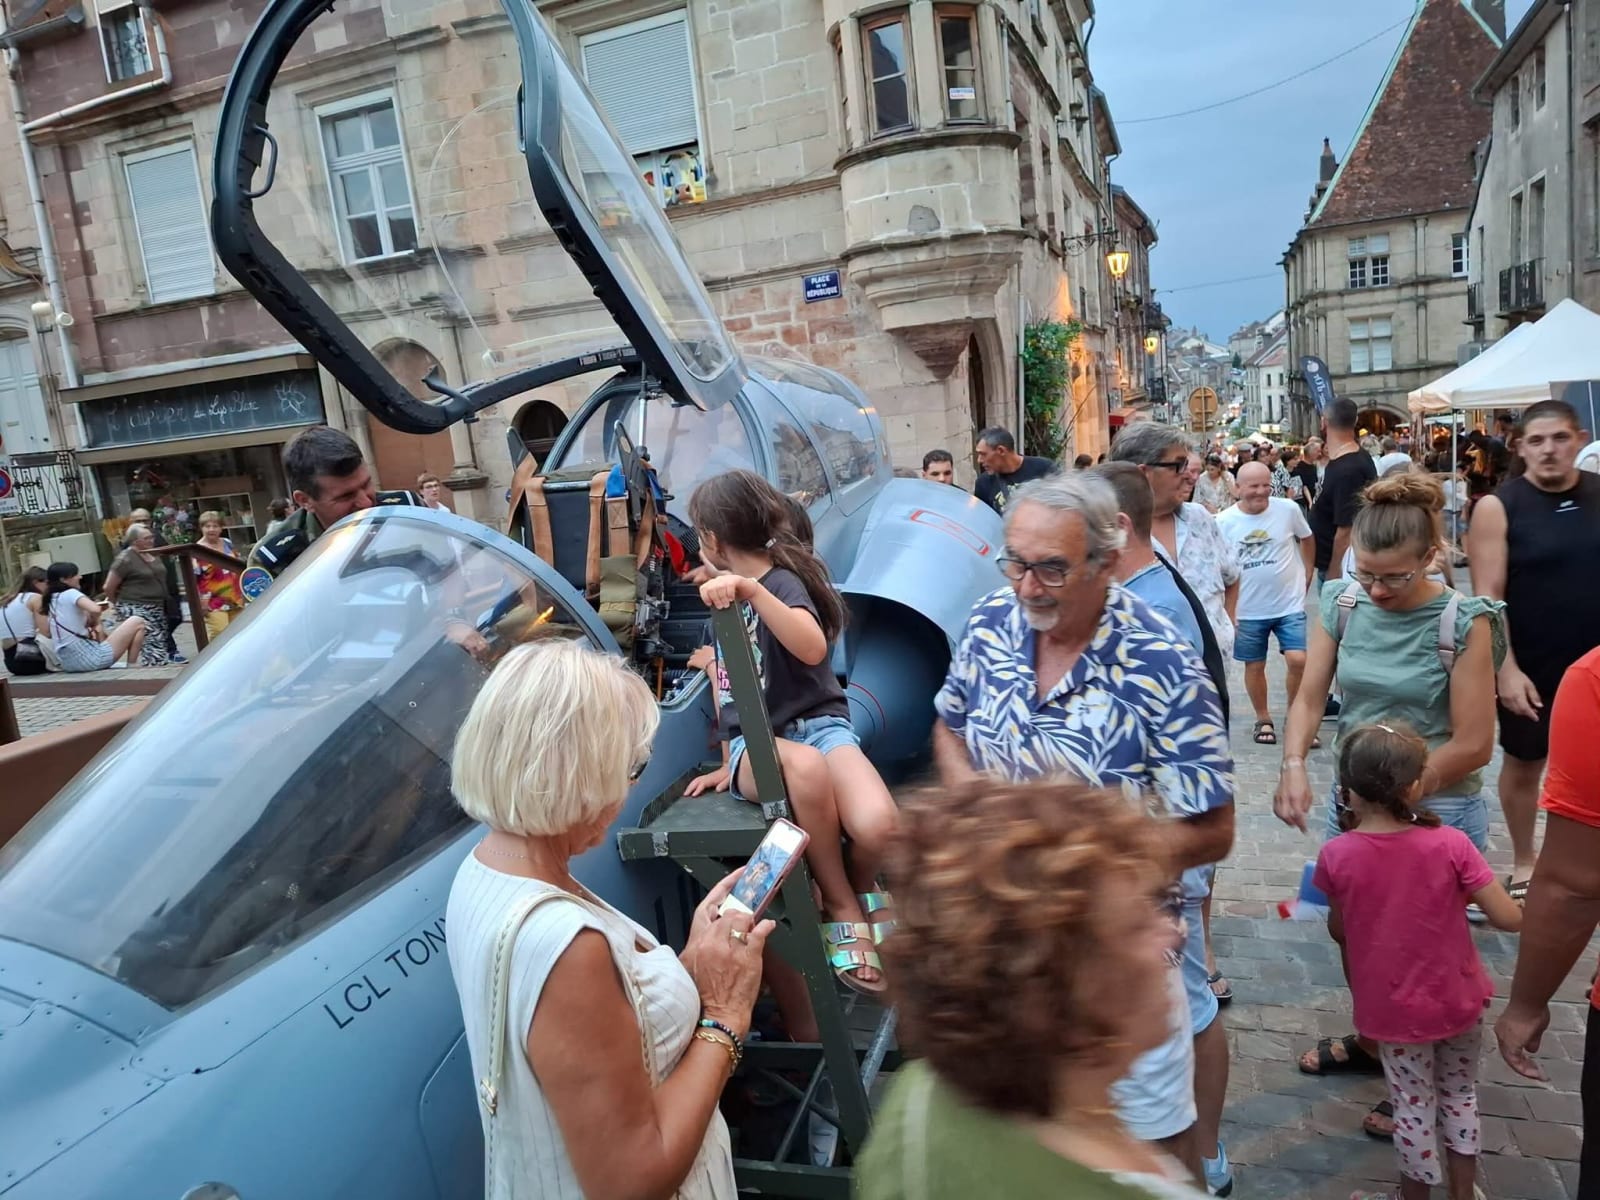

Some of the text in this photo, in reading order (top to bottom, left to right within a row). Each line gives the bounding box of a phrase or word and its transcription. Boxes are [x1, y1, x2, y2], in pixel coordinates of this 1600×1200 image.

[811, 275, 830, 284] PLACE
[806, 286, 838, 297] RÉPUBLIQUE
[323, 918, 446, 1029] LCL TON
